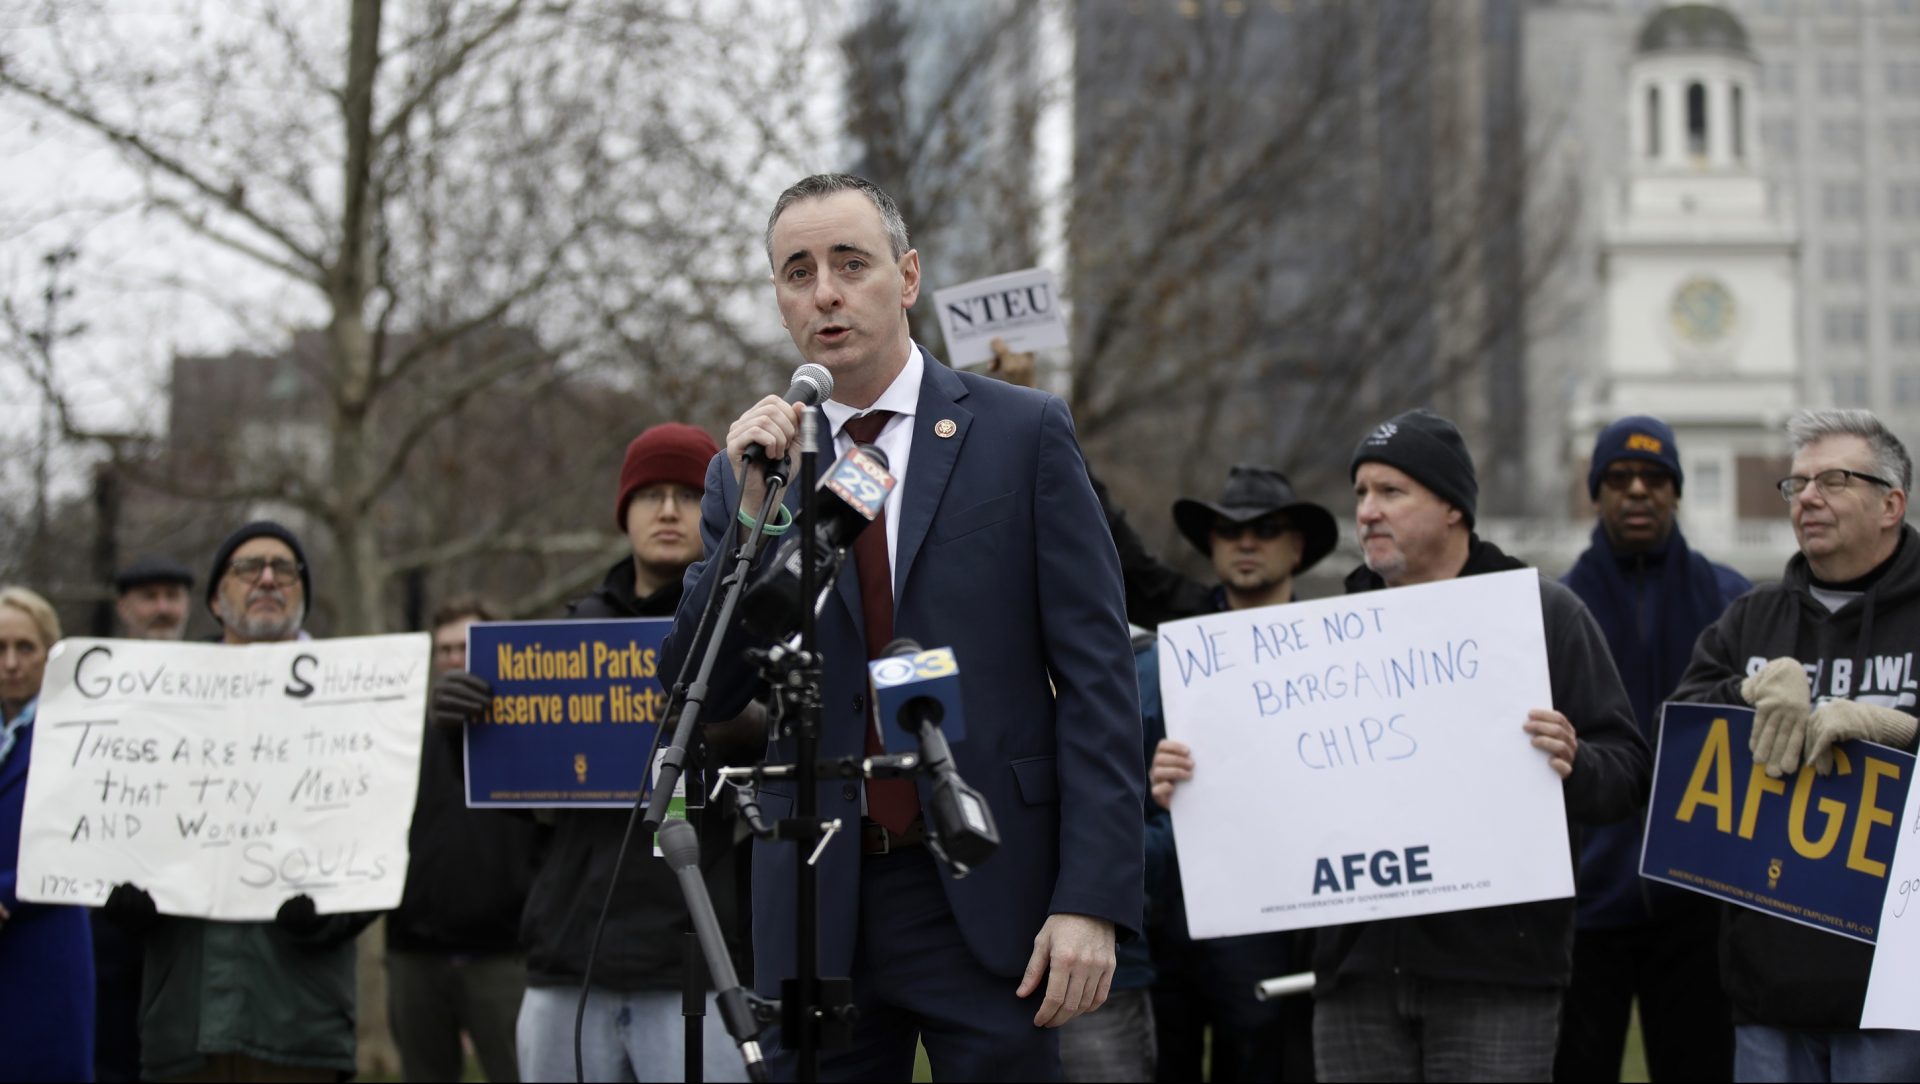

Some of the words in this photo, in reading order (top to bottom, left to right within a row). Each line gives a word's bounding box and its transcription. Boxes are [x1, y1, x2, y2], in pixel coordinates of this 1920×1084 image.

[945, 283, 1052, 333] NTEU
[836, 466, 882, 501] 29
[497, 640, 588, 681] National
[593, 640, 658, 680] Parks
[913, 650, 957, 680] 3
[1163, 625, 1235, 688] WE
[1252, 619, 1309, 664] ARE
[1324, 608, 1386, 645] NOT
[1253, 640, 1478, 718] BARGAINING
[568, 693, 605, 724] our
[172, 737, 237, 768] ARE
[1298, 714, 1417, 770] CHIPS
[1675, 718, 1900, 878] AFGE
[70, 814, 142, 842] AND
[239, 840, 389, 889] SOULS
[1311, 845, 1433, 895] AFGE
[1298, 898, 1344, 910] FEDERATION
[1345, 895, 1356, 904] OF
[1358, 890, 1410, 903] GOVERNMENT
